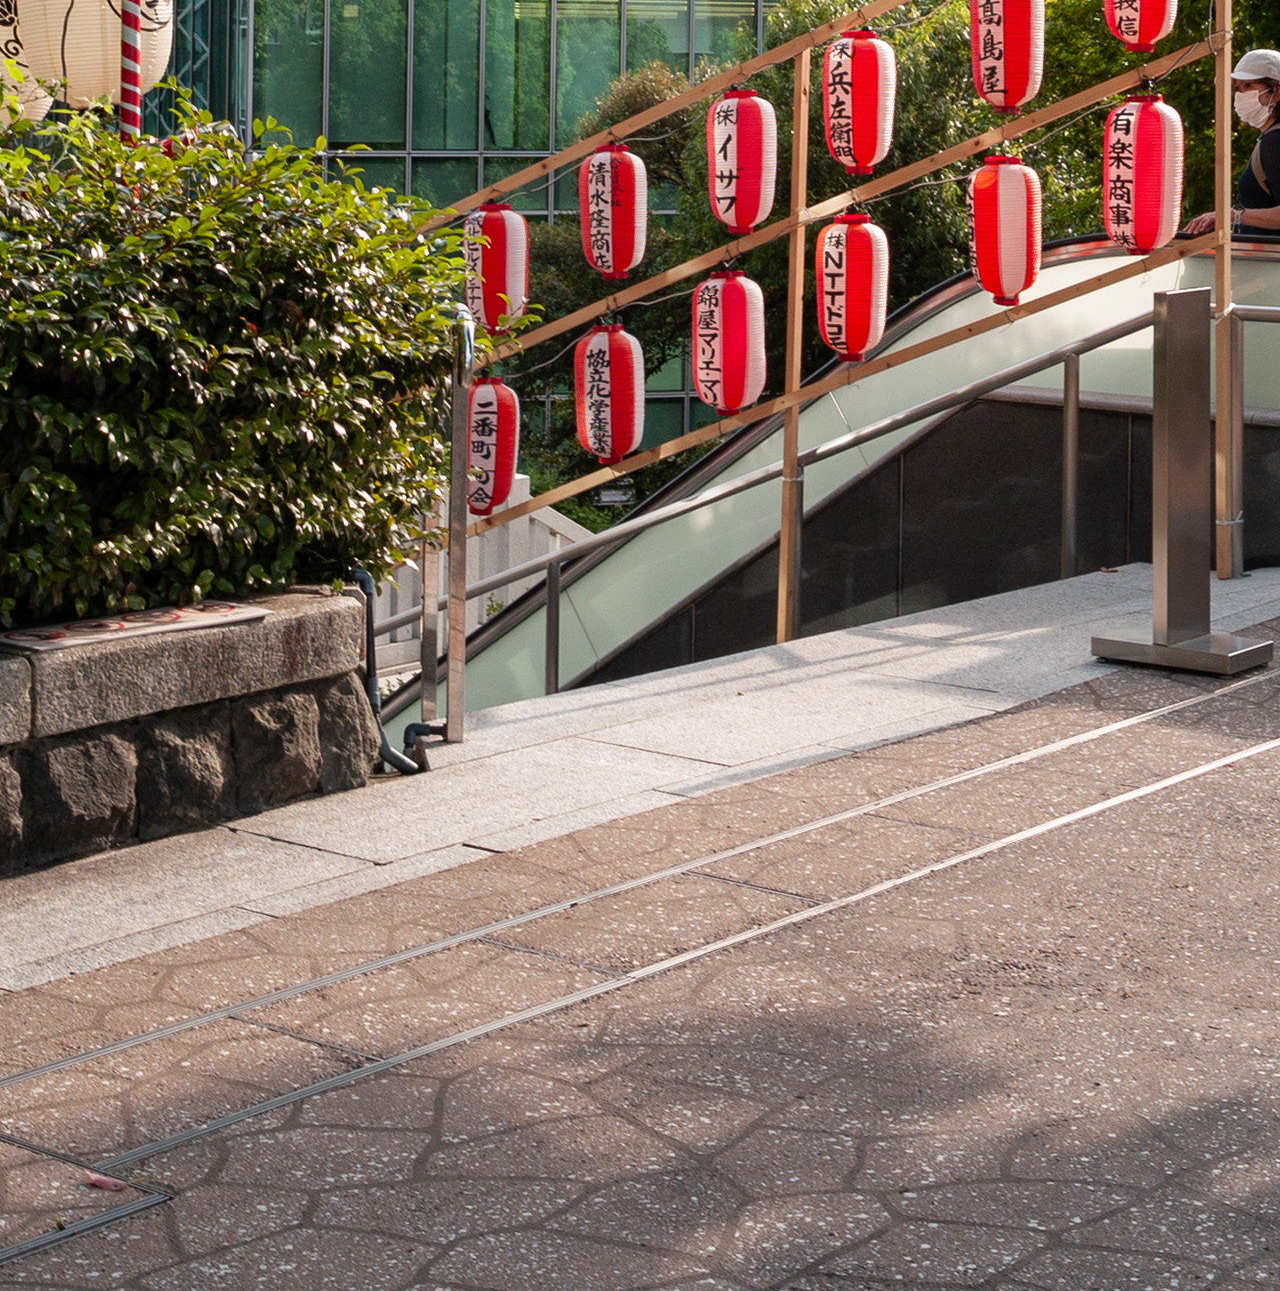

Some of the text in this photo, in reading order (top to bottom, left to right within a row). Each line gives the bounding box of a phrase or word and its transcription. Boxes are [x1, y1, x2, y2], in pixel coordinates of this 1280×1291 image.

[589, 162, 611, 269] 清水隆商店
